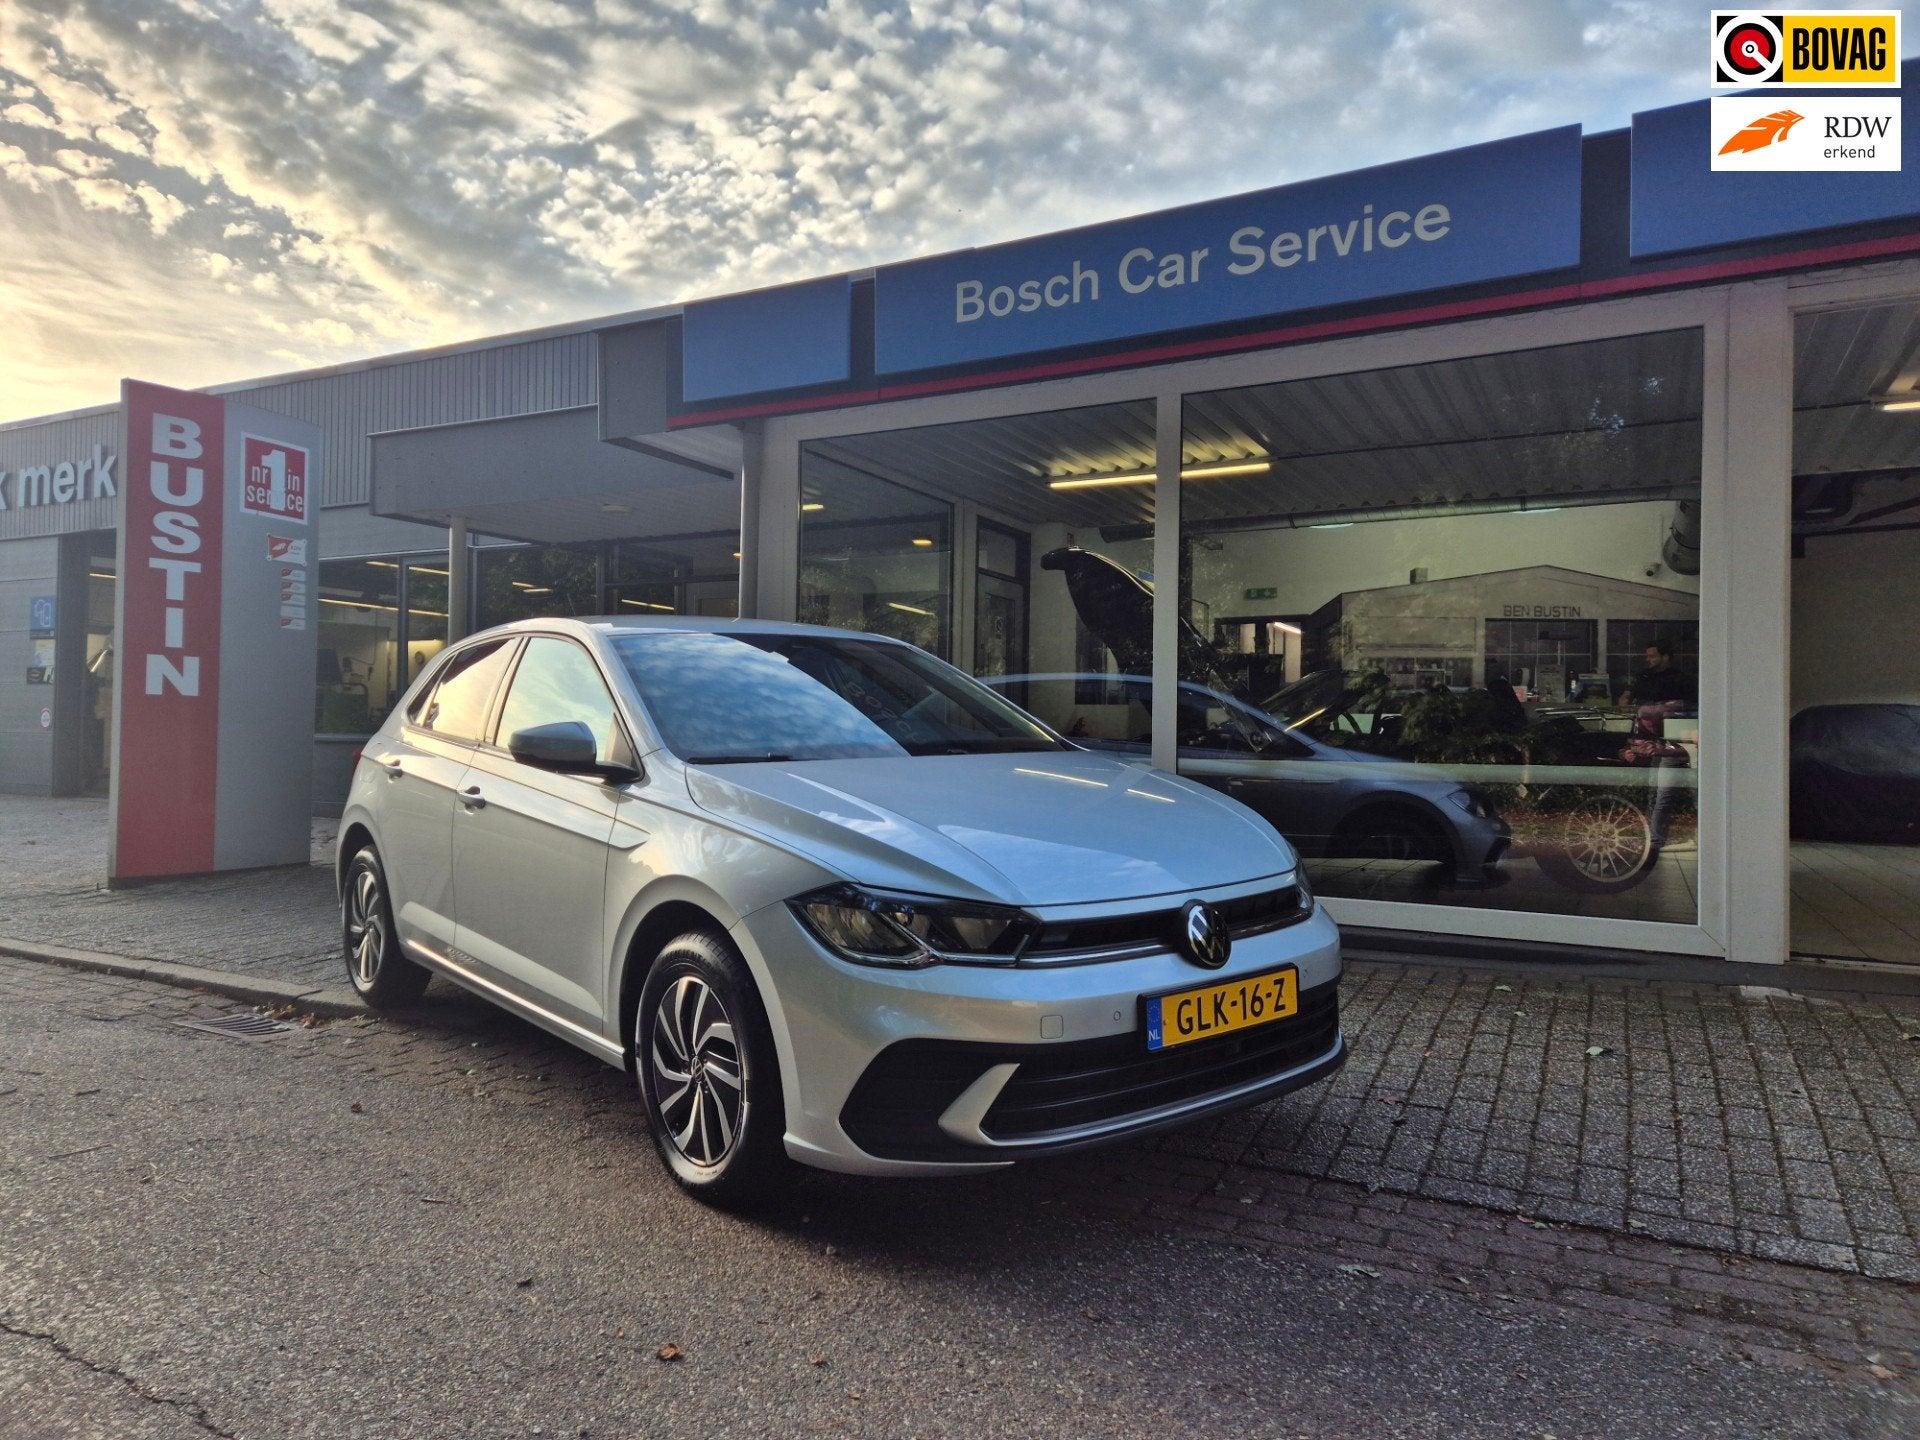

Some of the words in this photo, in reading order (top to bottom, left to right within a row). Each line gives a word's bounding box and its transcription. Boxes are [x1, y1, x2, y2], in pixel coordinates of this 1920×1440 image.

[955, 260, 1099, 323] Bosch
[1118, 247, 1209, 294] Car
[1227, 203, 1452, 275] Service
[18, 444, 117, 507] merk
[246, 485, 303, 513] serce
[252, 466, 269, 484] nr
[261, 449, 286, 512] 1
[287, 468, 300, 492] in
[145, 412, 204, 697] BUSTIN
[1503, 604, 1530, 617] BEN
[1533, 605, 1581, 618] BUSTIN
[1148, 1029, 1161, 1042] NL
[1176, 977, 1286, 1035] GLK-16-Z
